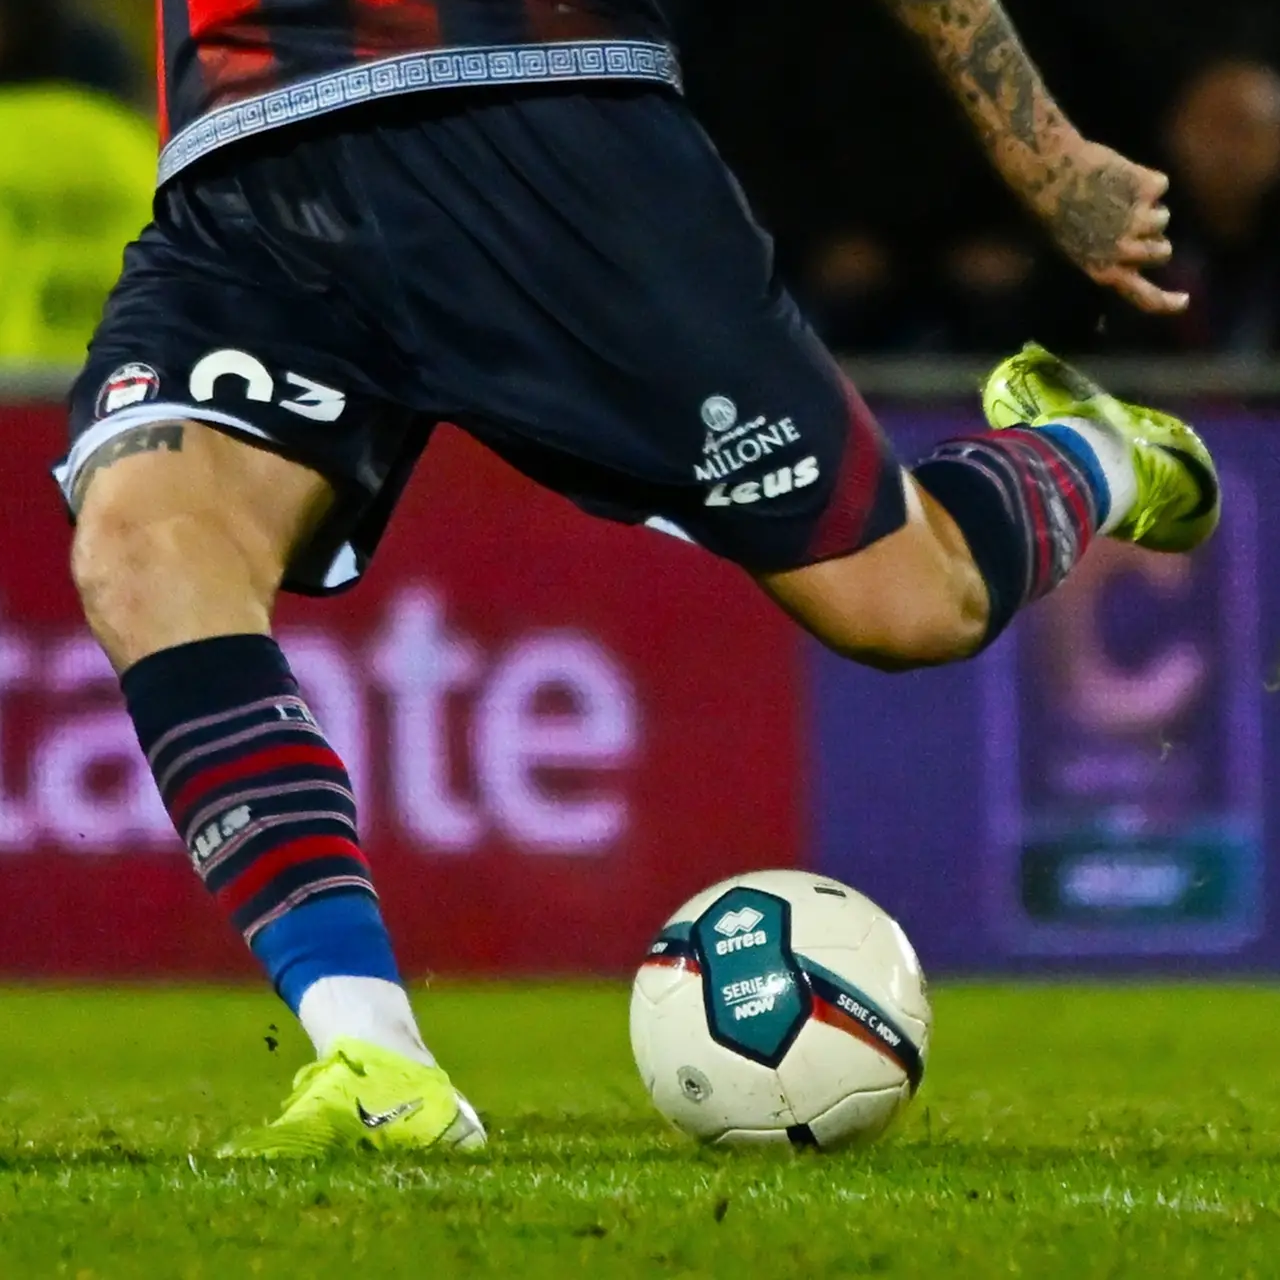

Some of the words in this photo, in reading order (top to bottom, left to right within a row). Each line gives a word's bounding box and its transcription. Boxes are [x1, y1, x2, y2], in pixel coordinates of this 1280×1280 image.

[693, 417, 802, 481] MILONE
[723, 976, 765, 1002] SERIE
[734, 995, 776, 1021] NOW
[837, 993, 869, 1022] SERIE
[868, 1015, 878, 1029] C
